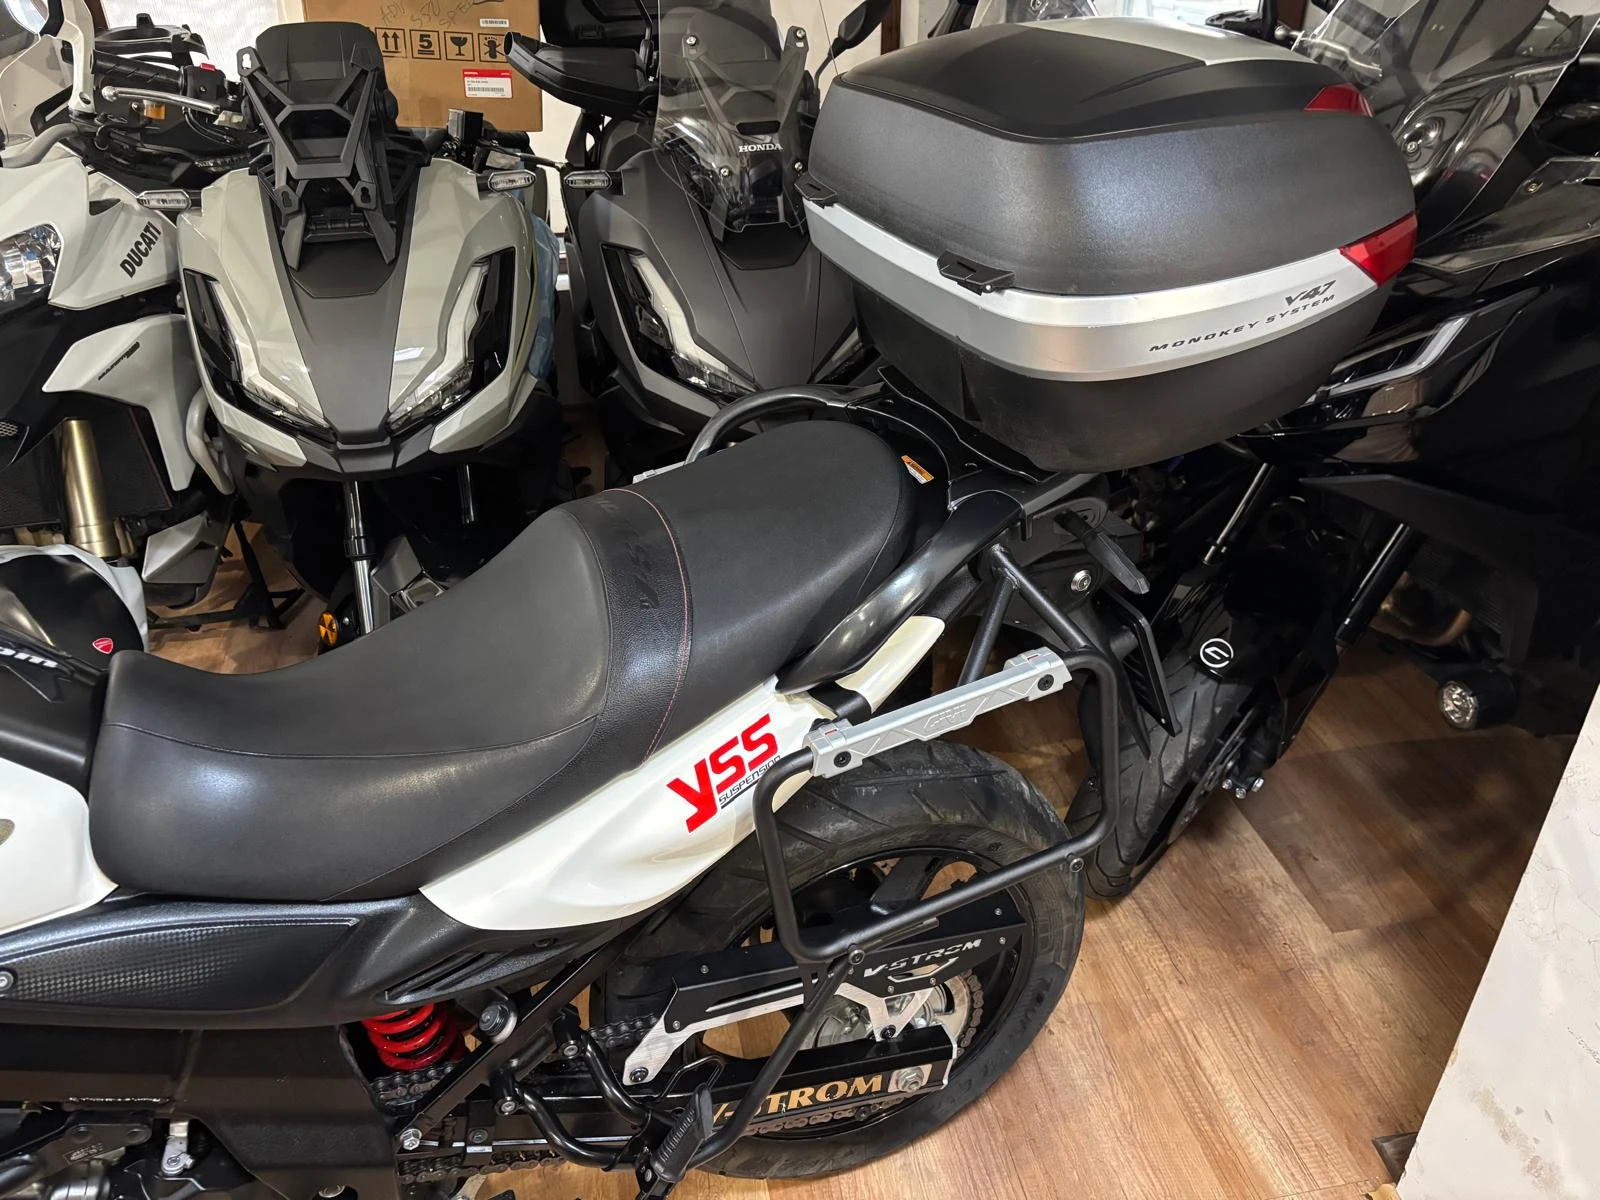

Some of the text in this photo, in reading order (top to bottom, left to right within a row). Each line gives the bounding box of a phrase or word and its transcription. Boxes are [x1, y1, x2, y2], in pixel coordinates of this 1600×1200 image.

[419, 34, 433, 49] 5
[739, 143, 784, 153] HONDA
[120, 220, 161, 278] DUCATI
[1285, 279, 1337, 307] V47
[1149, 294, 1336, 352] MONOKEY SYSTEM
[863, 939, 982, 978] V-STROM
